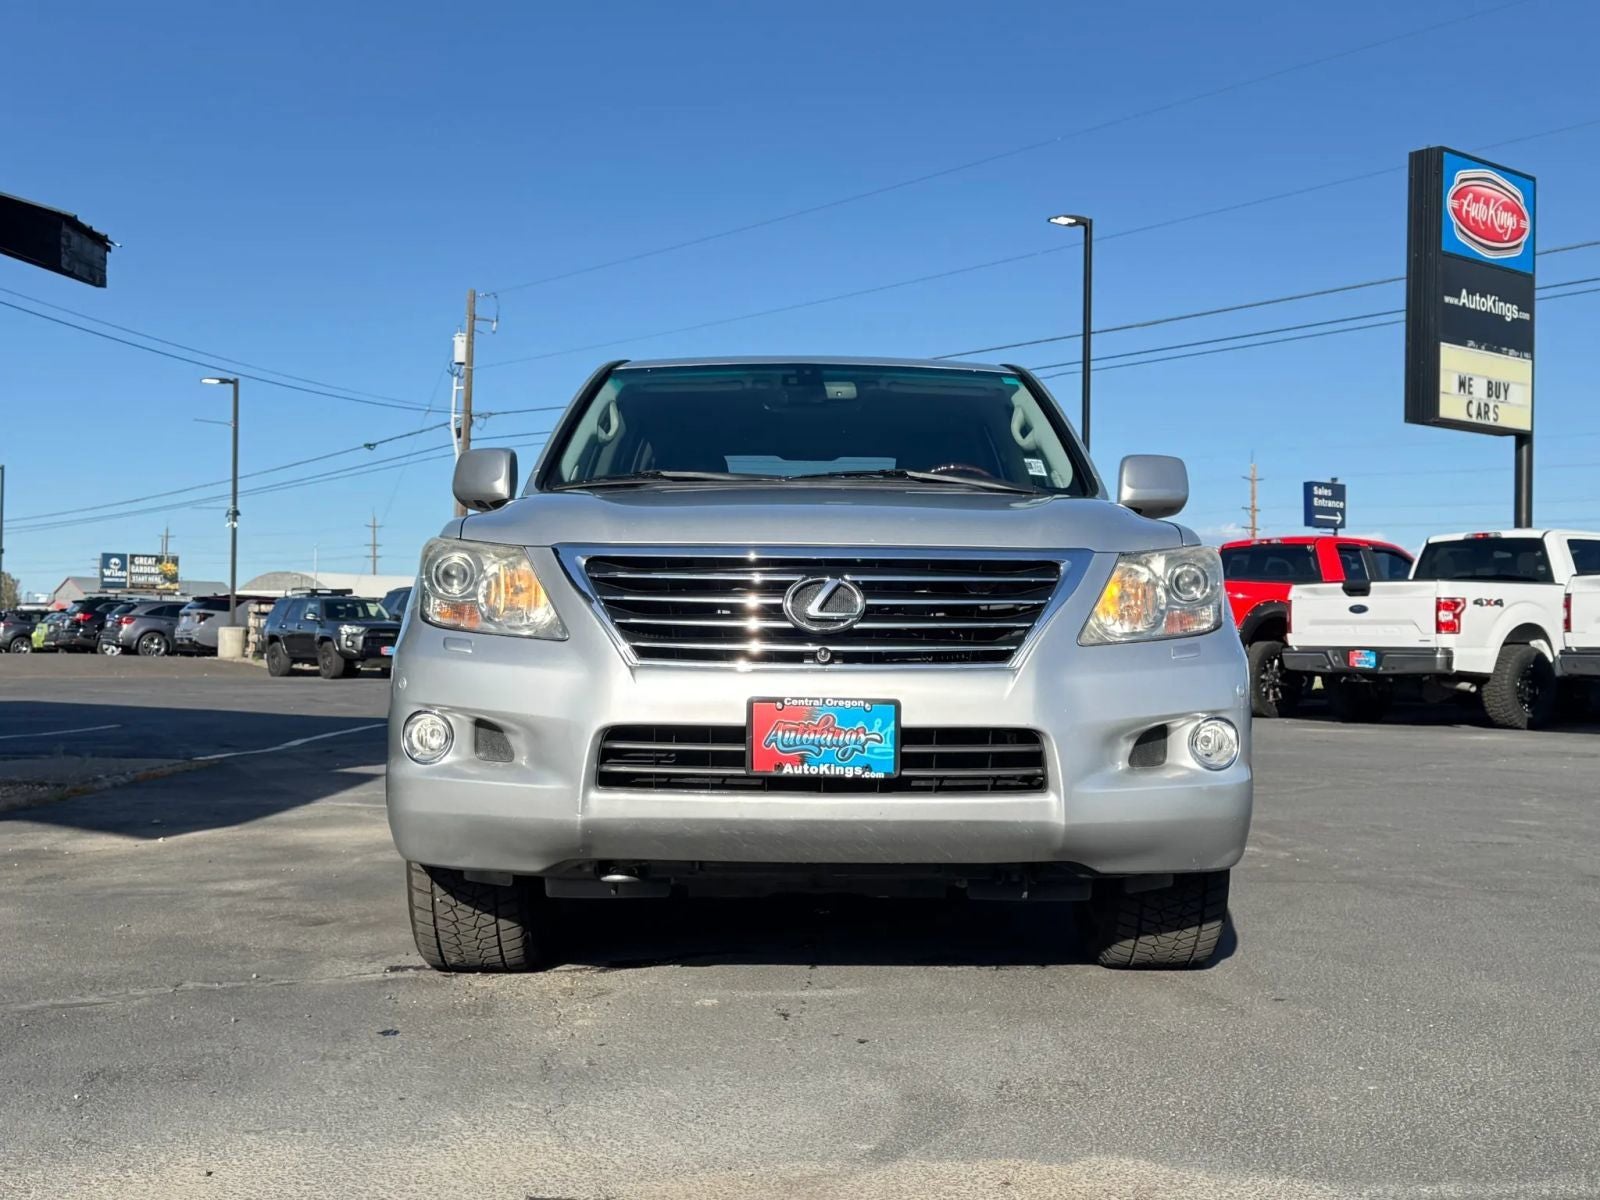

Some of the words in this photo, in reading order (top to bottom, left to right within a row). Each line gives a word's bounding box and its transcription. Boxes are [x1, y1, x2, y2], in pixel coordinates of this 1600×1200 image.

[1460, 193, 1518, 240] AutoKings
[1444, 288, 1531, 321] www.AutoKings.com
[1458, 374, 1474, 395] WE
[1487, 381, 1511, 400] BUY
[1466, 400, 1499, 422] CARS
[1313, 486, 1332, 496] Sales
[1313, 497, 1344, 508] Entrance
[134, 557, 156, 565] GREAT
[103, 568, 127, 576] Wilco
[131, 565, 159, 573] GARDENS
[784, 697, 822, 706] Central
[826, 698, 864, 708] Oregon
[782, 763, 884, 778] AutoKings.com
